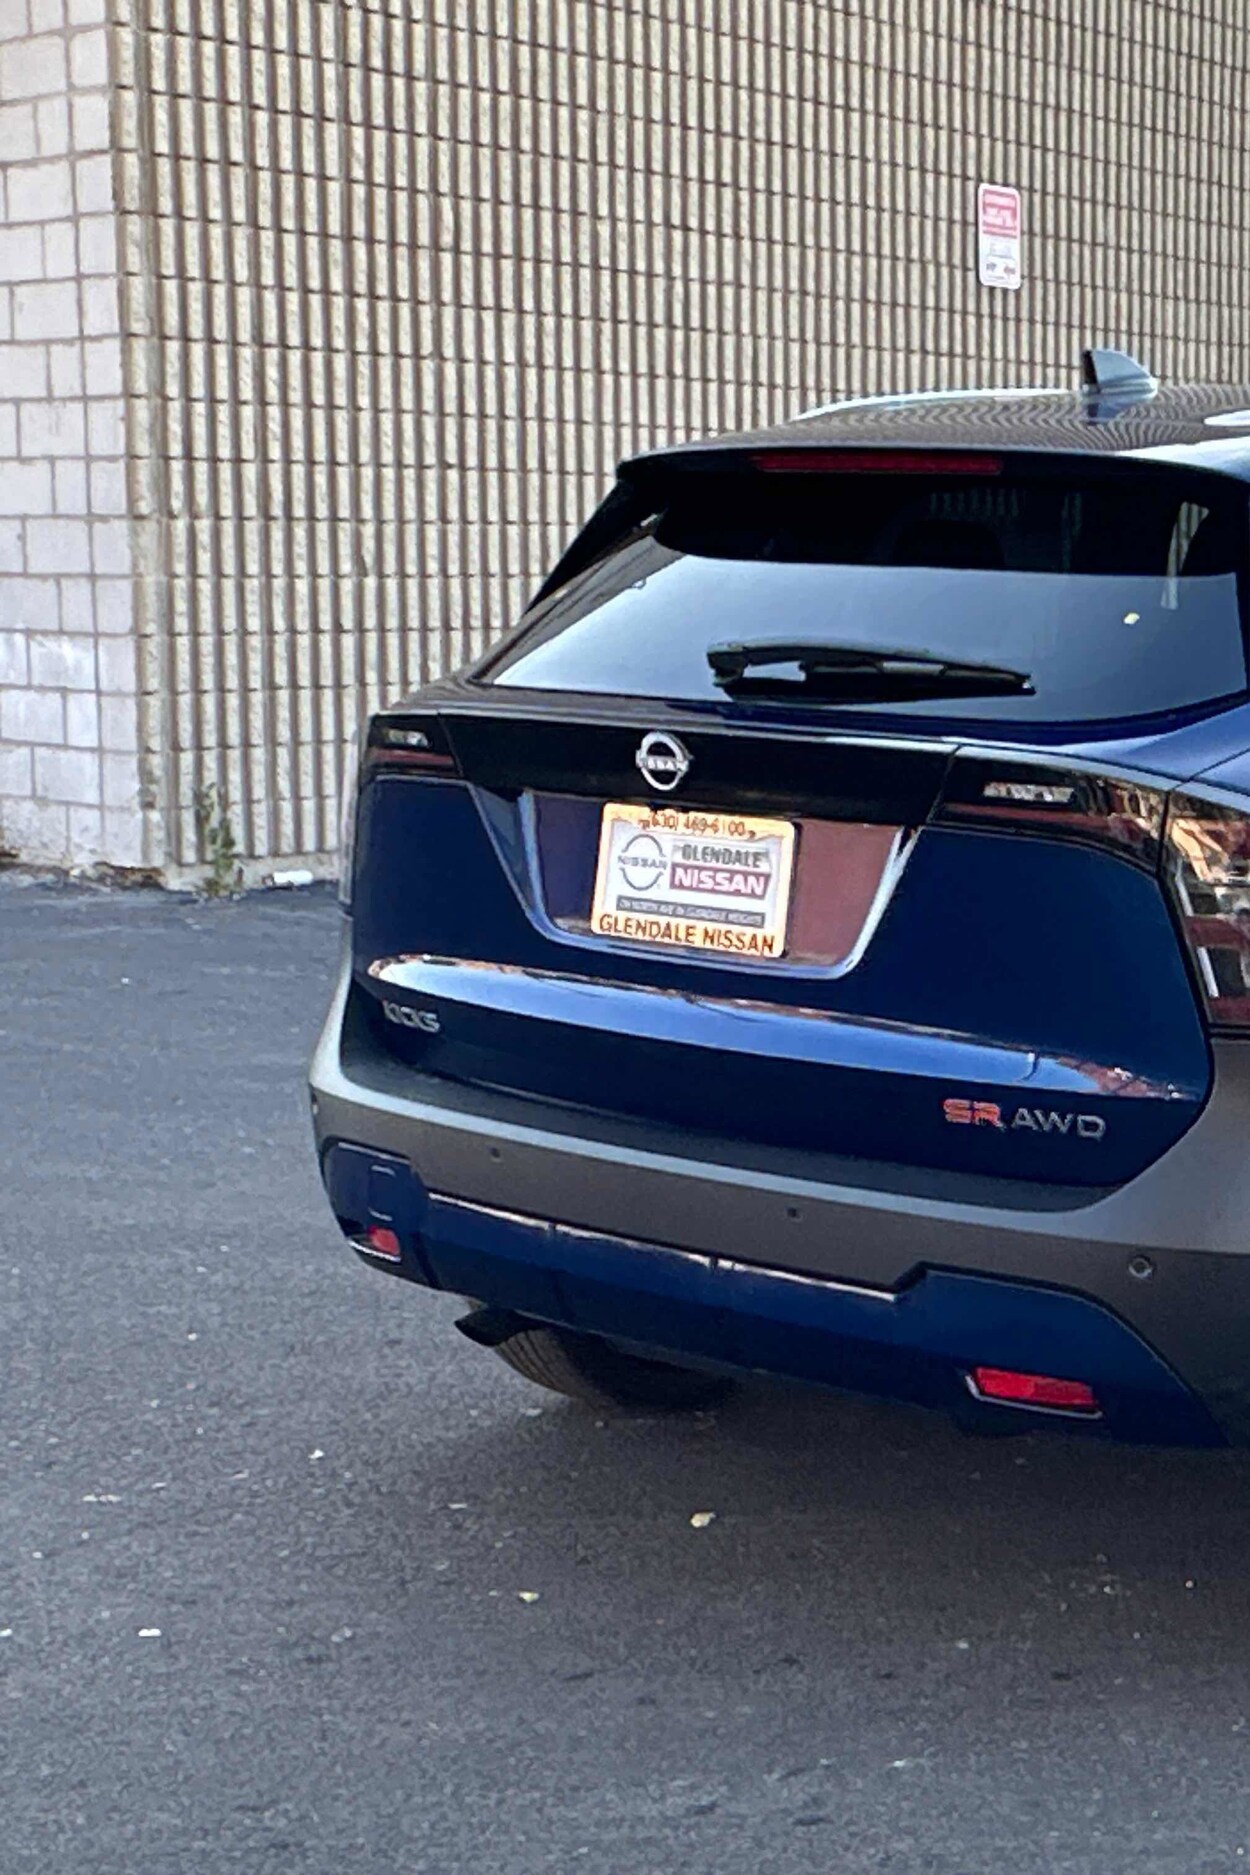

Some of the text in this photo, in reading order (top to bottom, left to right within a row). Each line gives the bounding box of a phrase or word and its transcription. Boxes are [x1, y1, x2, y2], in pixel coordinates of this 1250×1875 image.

[617, 854, 667, 870] NISSAN
[681, 844, 762, 868] GLENDALE
[674, 867, 766, 896] NISSAN
[599, 914, 775, 953] GLENDALE NISSAN
[943, 1098, 1106, 1141] SR AWD
